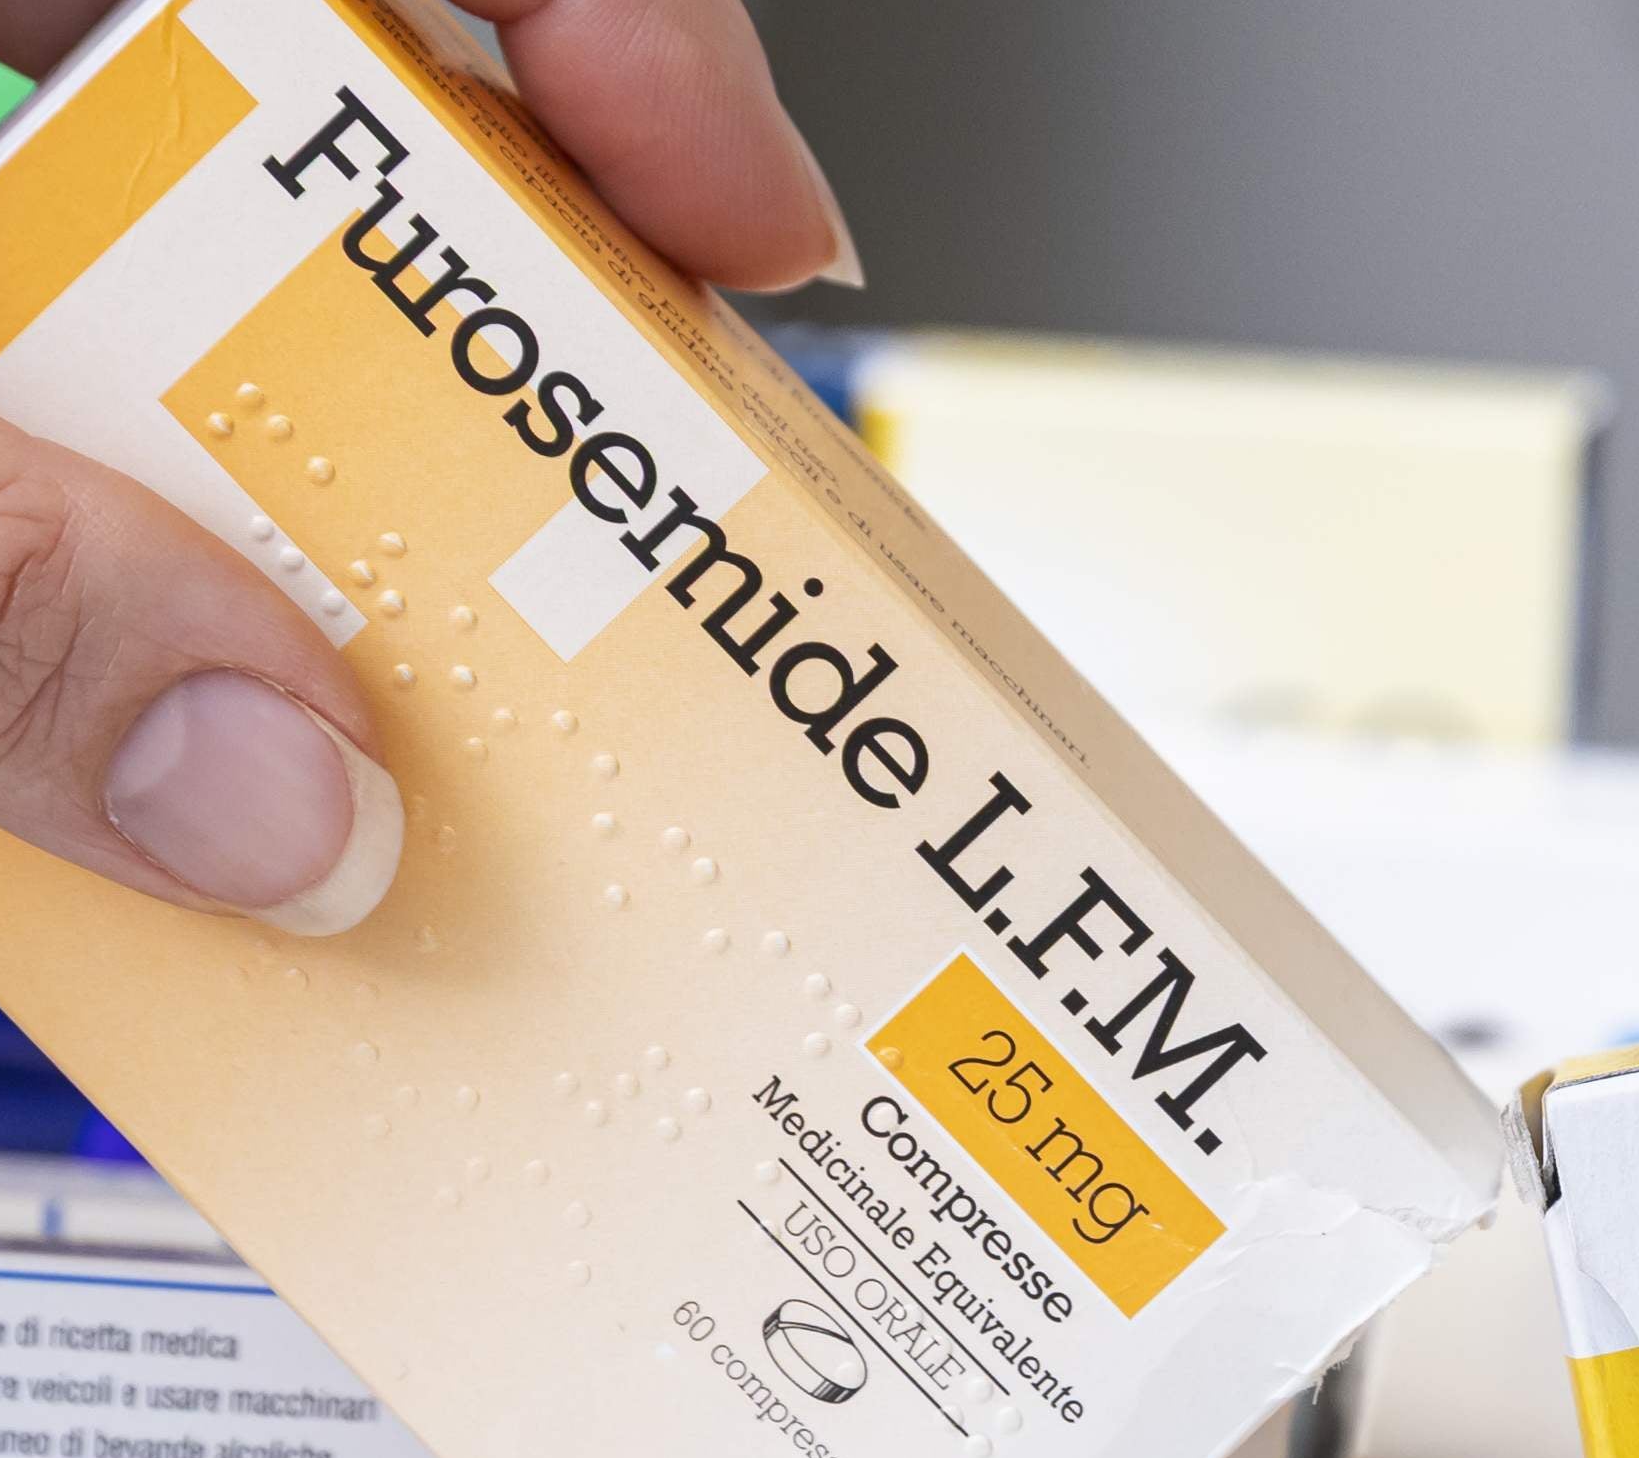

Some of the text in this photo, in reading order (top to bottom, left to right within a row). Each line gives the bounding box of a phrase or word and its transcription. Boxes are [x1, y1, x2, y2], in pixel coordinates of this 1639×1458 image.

[454, 81, 532, 159] foglio
[532, 162, 660, 293] illustrativo
[658, 295, 739, 377] prima
[369, 7, 469, 109] alterare
[469, 111, 495, 138] la
[495, 142, 605, 254] capacità
[606, 256, 635, 285] di
[635, 288, 738, 393] guidare
[737, 396, 822, 482] veicoli
[824, 486, 843, 506] e
[845, 509, 876, 539] di
[875, 541, 947, 615] usare
[947, 617, 1096, 769] macchinari.
[263, 86, 1267, 1155] Furosemide L.F.M.
[862, 1096, 1072, 1322] Compresse
[948, 1031, 1149, 1244] 25 mg
[16, 1317, 39, 1347] di
[49, 1321, 132, 1354] ricetta
[142, 1327, 239, 1360] medica
[674, 1301, 715, 1341] 60
[752, 1075, 1083, 1423] Medicinale Equivalente
[785, 1201, 966, 1390] USO ORALE
[27, 1374, 112, 1407] veicoli
[122, 1384, 137, 1407] e
[146, 1386, 220, 1413] usare
[61, 1428, 84, 1458] di
